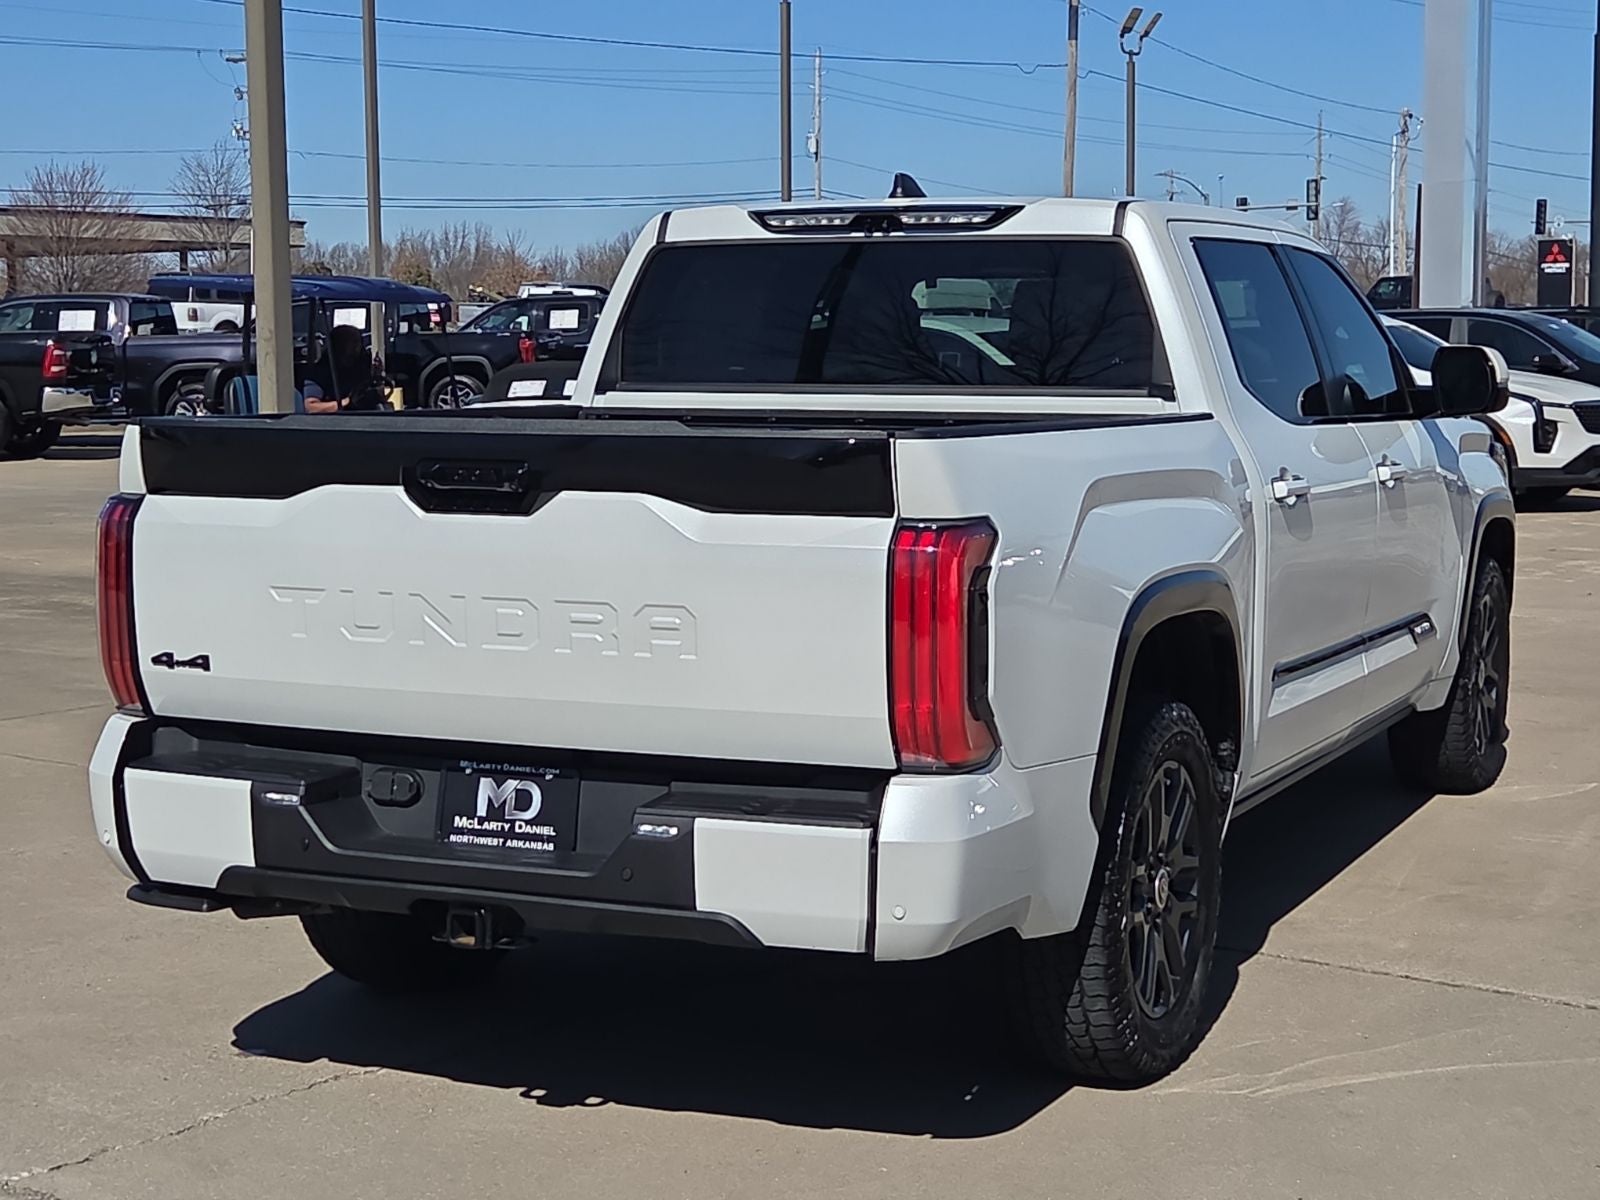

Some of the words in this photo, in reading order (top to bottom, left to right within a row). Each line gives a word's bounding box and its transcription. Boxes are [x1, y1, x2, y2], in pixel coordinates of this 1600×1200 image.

[269, 585, 698, 661] TUNDRA
[476, 777, 543, 820] MD
[449, 834, 504, 847] NORTHWEST
[505, 839, 555, 851] ARKANSAS
[514, 821, 557, 836] DANIEL
